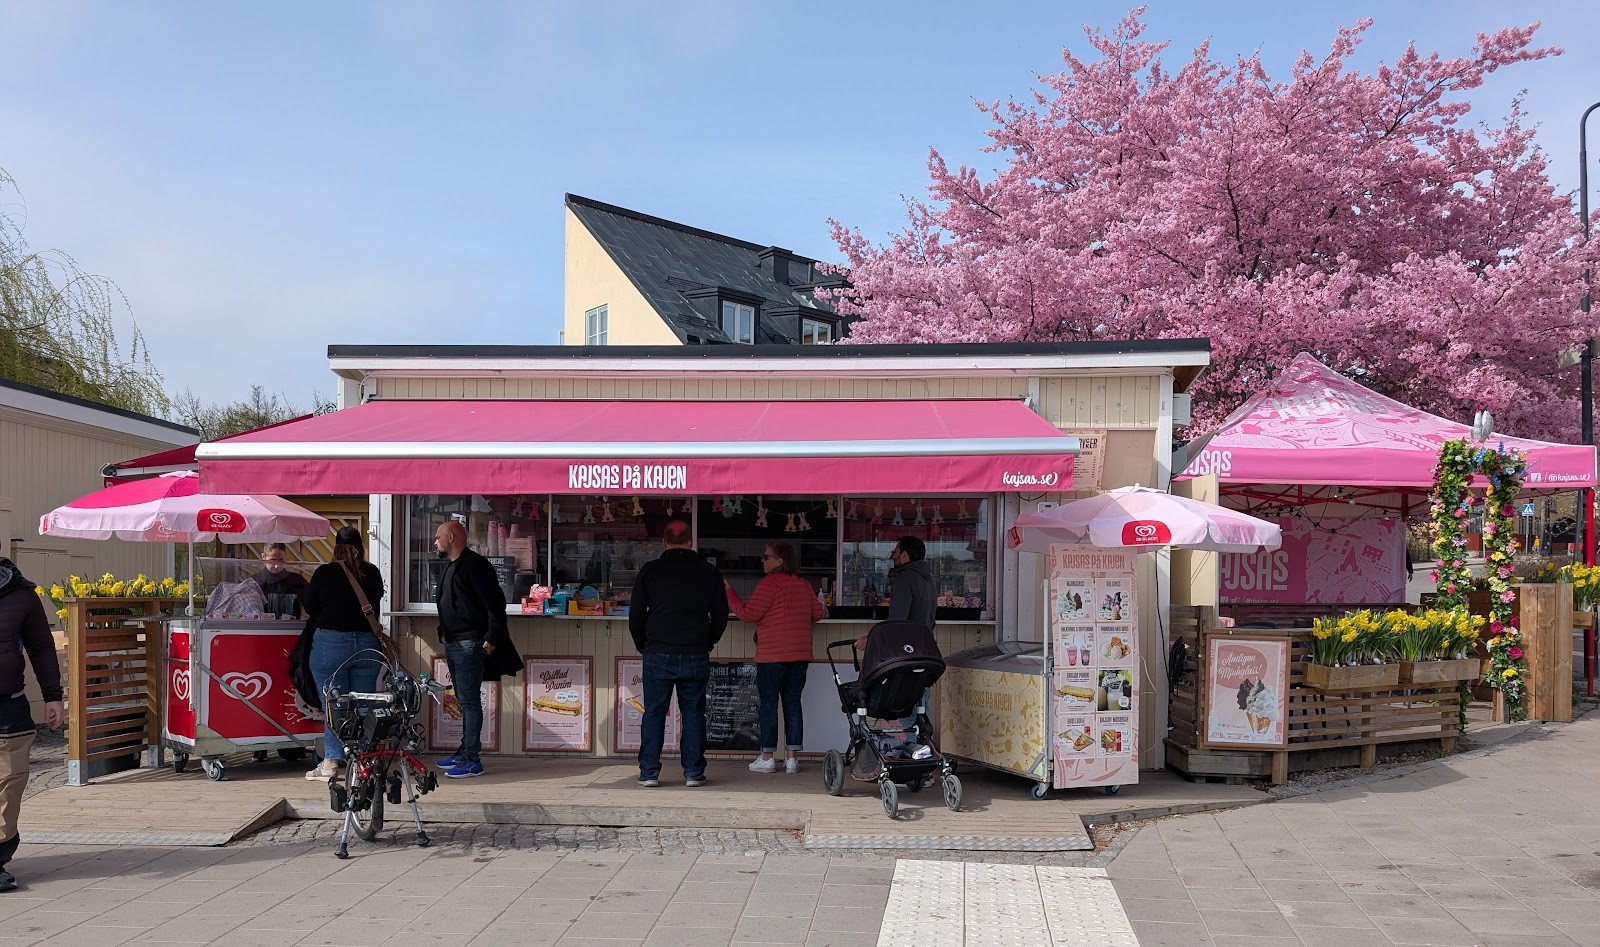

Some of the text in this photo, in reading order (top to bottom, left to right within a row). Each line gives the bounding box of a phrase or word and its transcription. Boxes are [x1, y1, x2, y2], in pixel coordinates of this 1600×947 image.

[568, 464, 620, 489] KAJSAS
[1061, 554, 1090, 569] KAJSAS
[540, 668, 570, 685] Grillad
[545, 679, 572, 693] Panini
